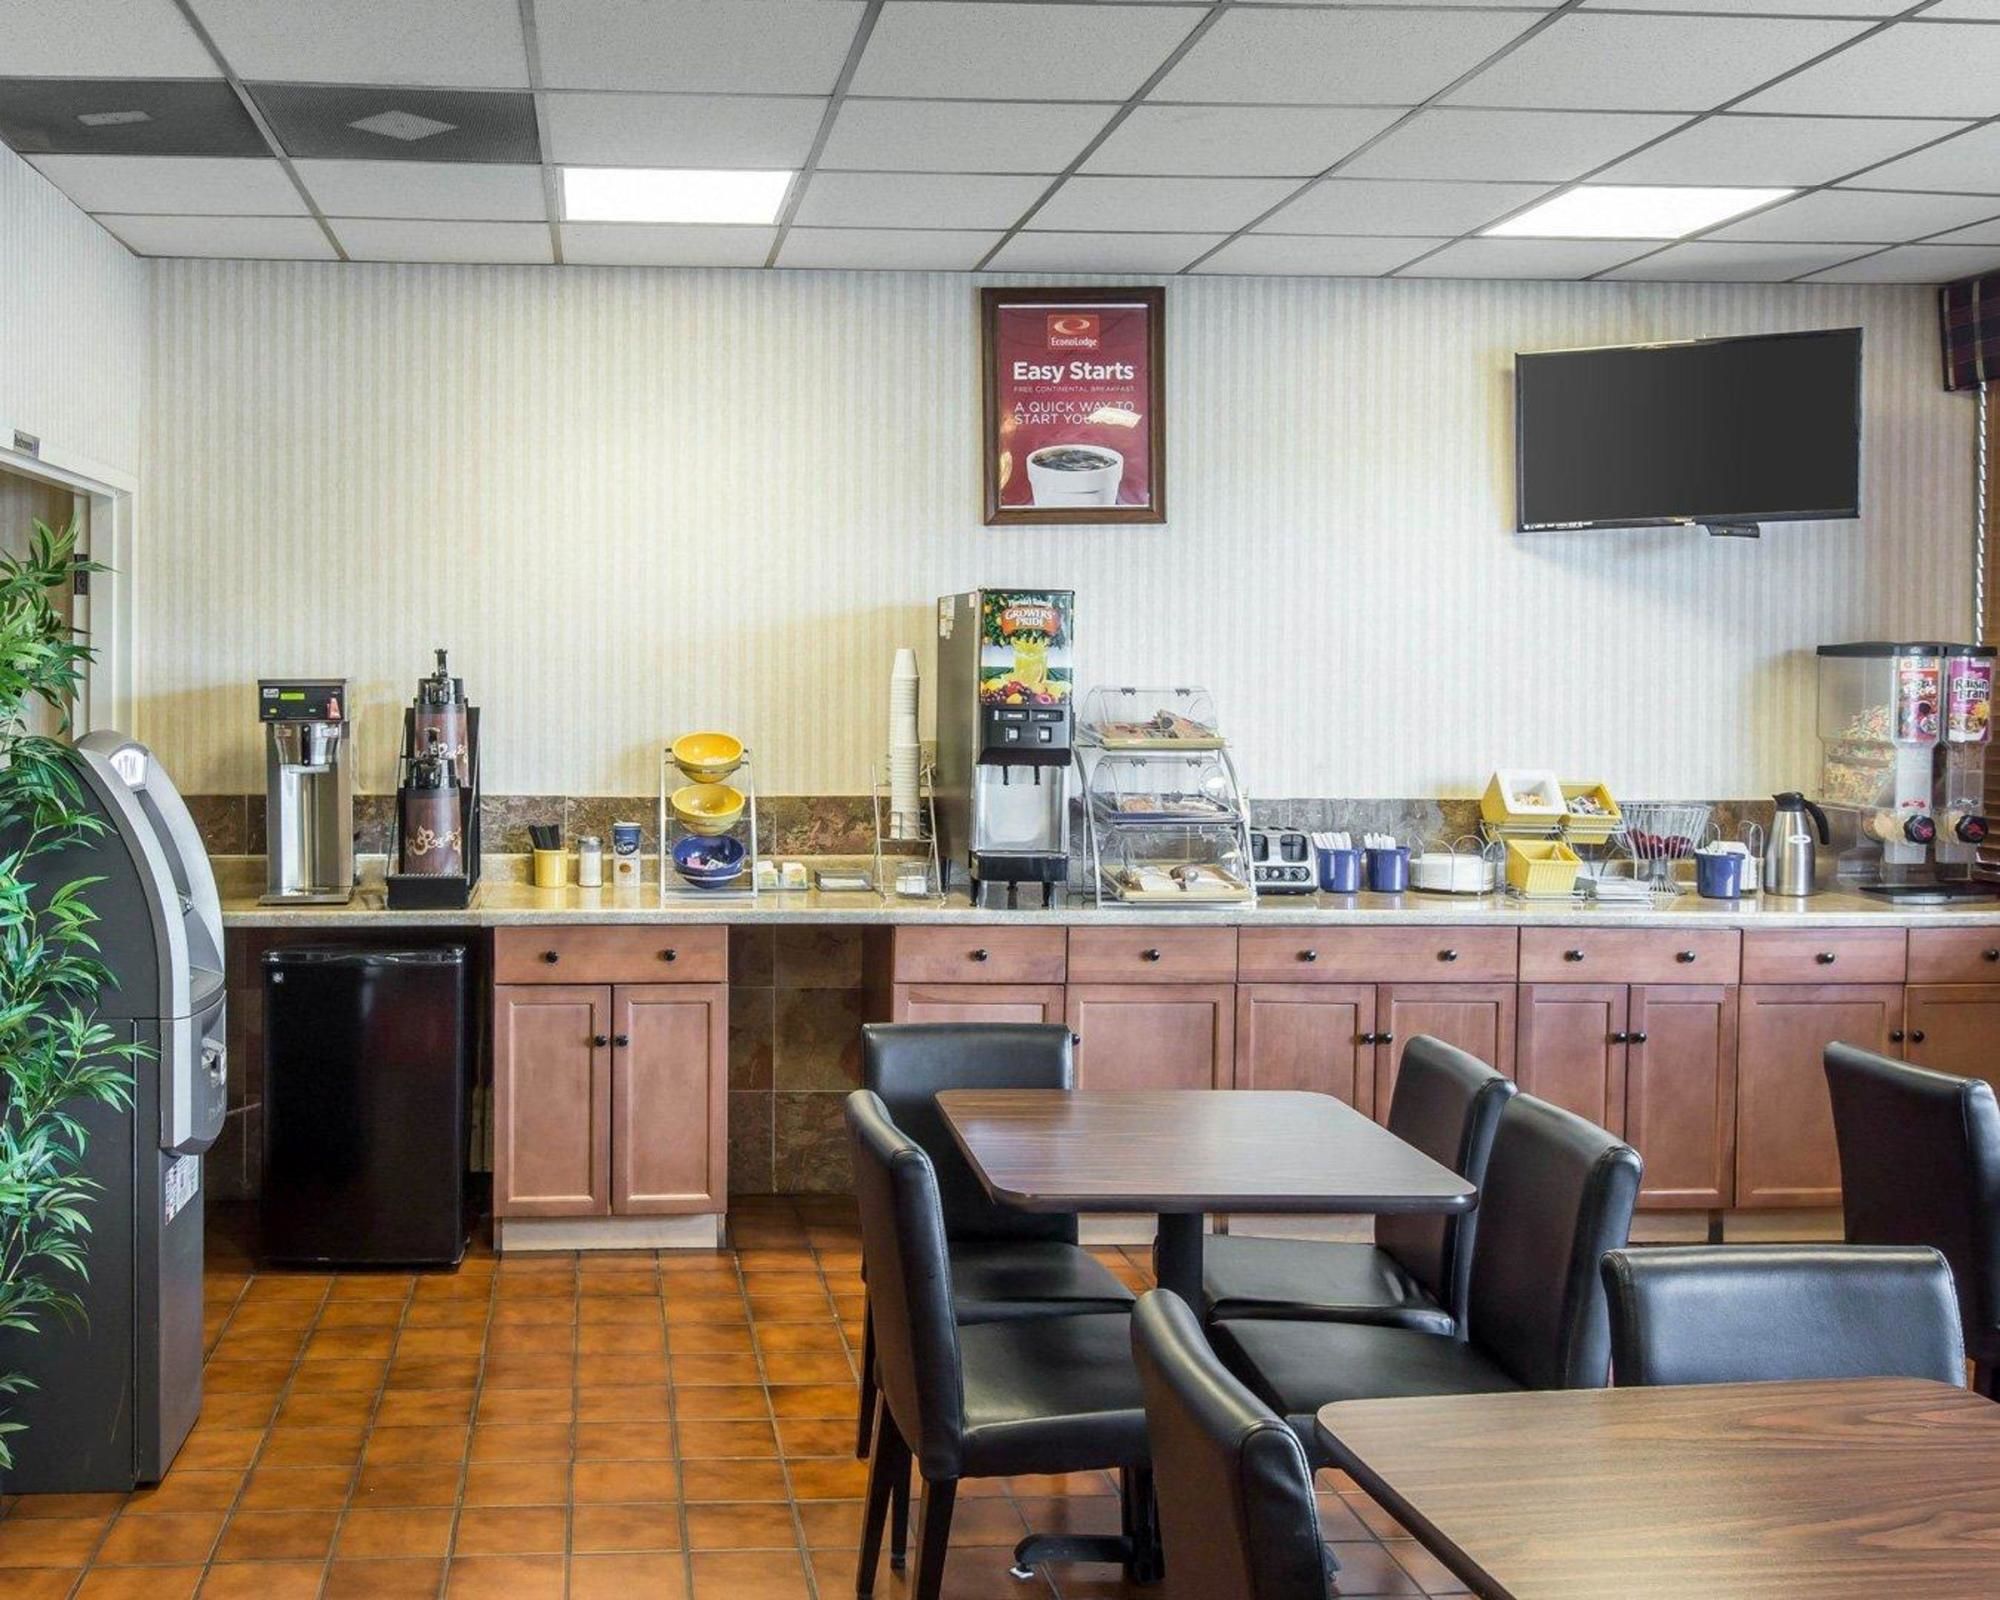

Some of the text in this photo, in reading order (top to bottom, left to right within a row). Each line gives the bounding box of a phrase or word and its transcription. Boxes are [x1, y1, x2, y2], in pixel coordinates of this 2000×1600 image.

[1051, 336, 1097, 348] EconoLodge
[1013, 361, 1135, 383] Easy Starts
[1014, 401, 1134, 413] A QUICK WAY TO
[1014, 413, 1099, 425] START YOU
[1955, 679, 1988, 690] Raisin
